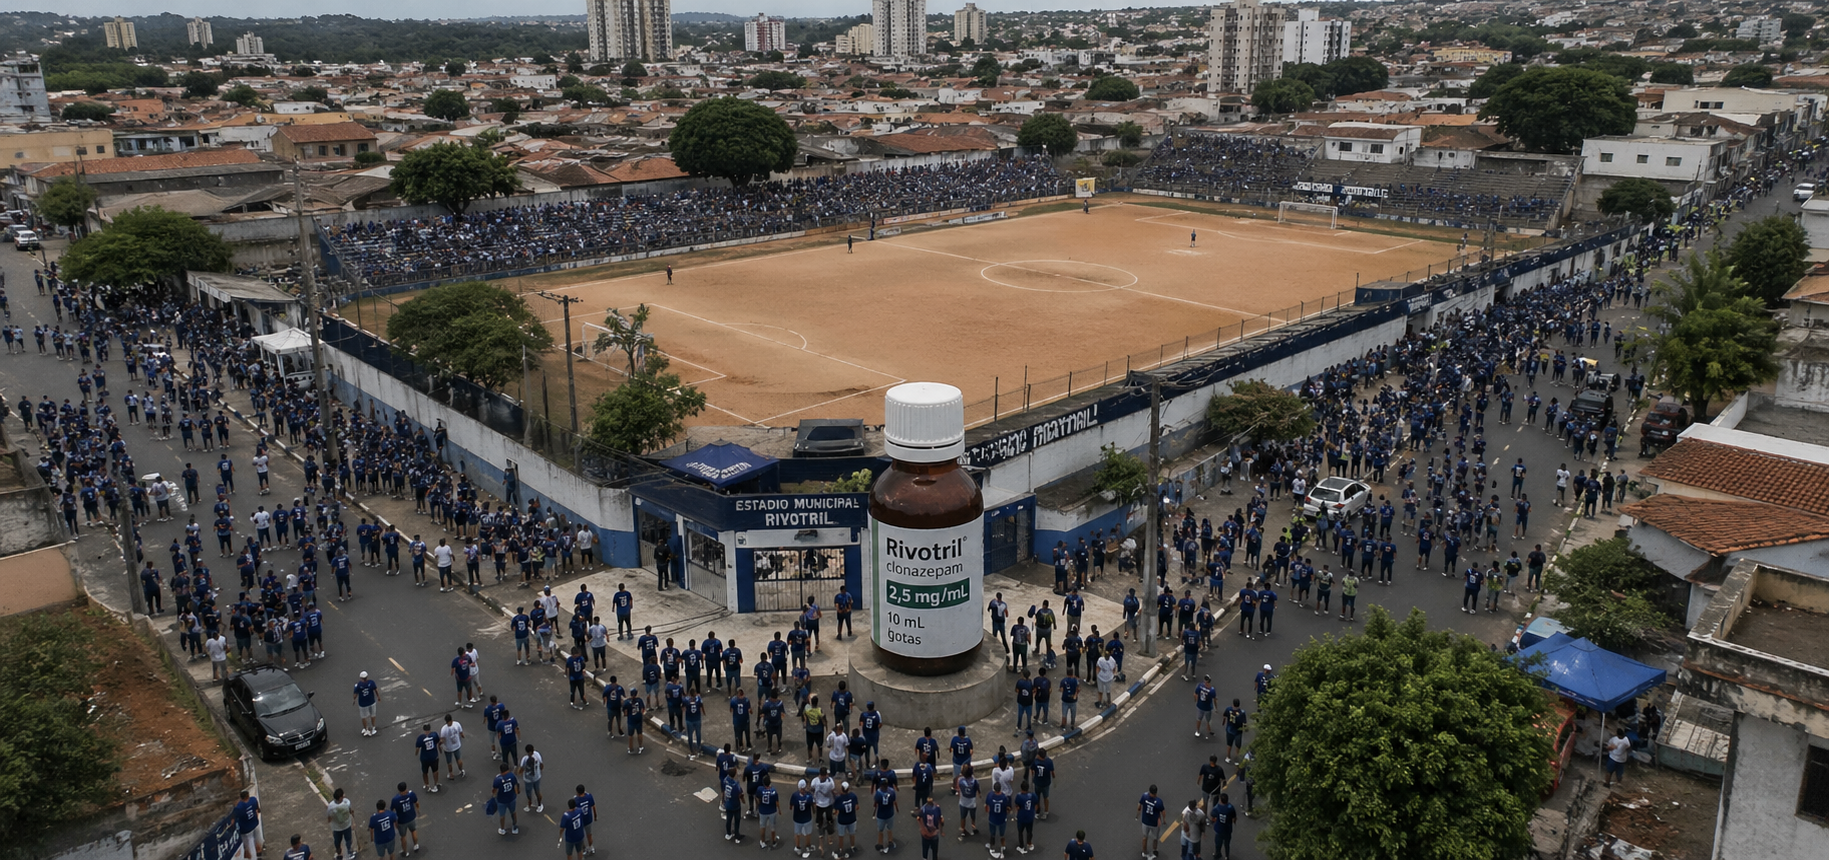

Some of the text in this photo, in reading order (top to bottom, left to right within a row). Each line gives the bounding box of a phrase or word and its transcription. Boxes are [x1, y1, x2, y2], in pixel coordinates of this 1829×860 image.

[735, 499, 789, 511] ESTADIO
[886, 561, 963, 579] clonazepam
[889, 584, 968, 606] 2,5 mg/mL
[888, 611, 925, 629] 10 mL
[887, 627, 922, 645] gotas
